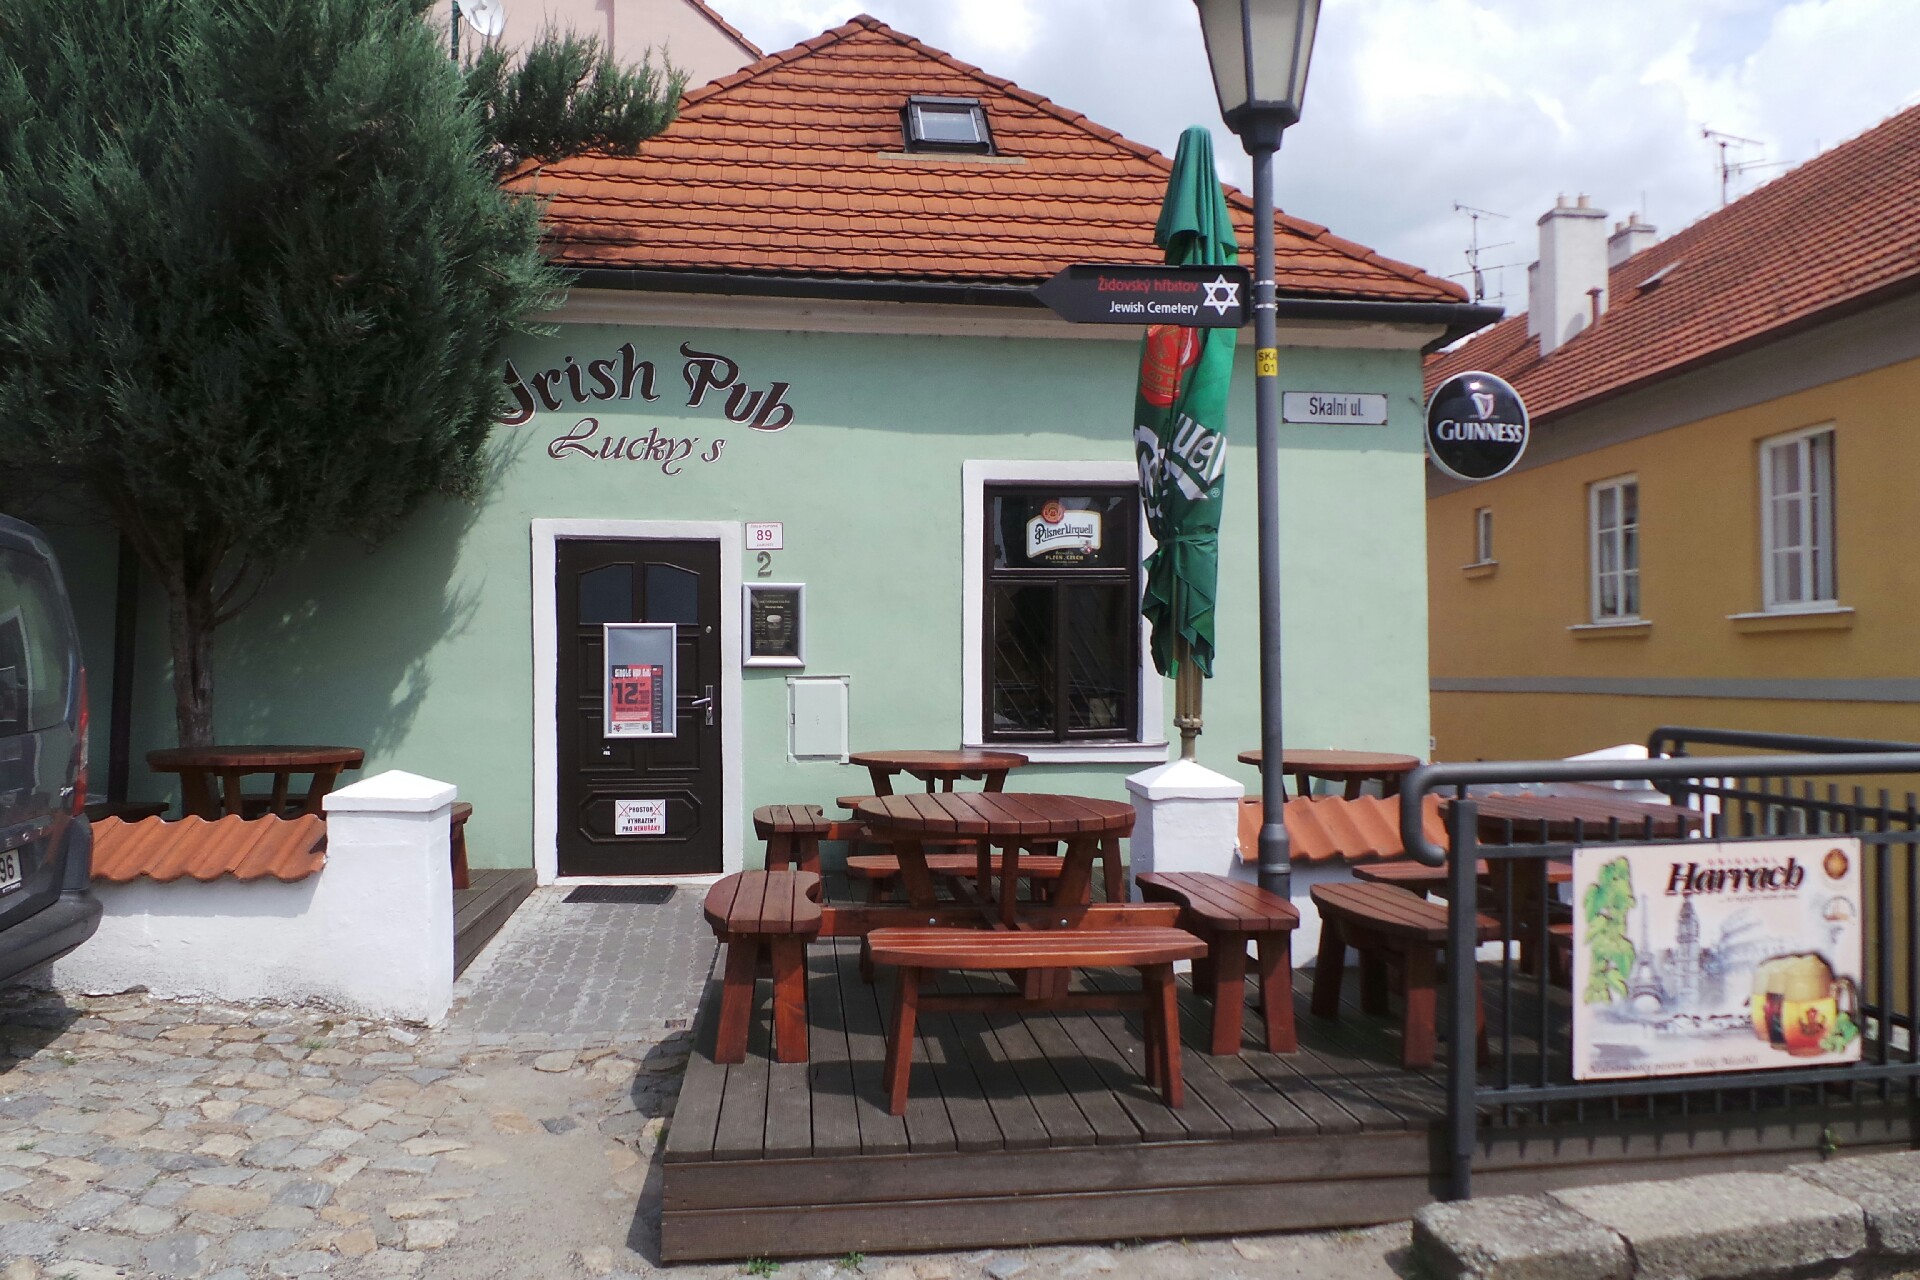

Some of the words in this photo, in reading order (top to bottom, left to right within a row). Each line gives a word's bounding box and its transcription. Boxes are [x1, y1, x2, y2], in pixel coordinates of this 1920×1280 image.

[1098, 275, 1150, 294] Židovský
[1154, 278, 1198, 292] hřbitov
[1110, 301, 1145, 313] Jewish
[1147, 301, 1198, 316] Cemetery
[498, 342, 661, 427] Irish
[679, 340, 796, 433] Pub
[1309, 396, 1347, 416] Skalní
[1350, 399, 1364, 417] ul.
[1436, 419, 1524, 443] GUINNESS
[756, 529, 773, 541] 89
[1034, 523, 1066, 546] Pilsner
[1064, 522, 1094, 539] Urquell
[756, 551, 772, 579] 2
